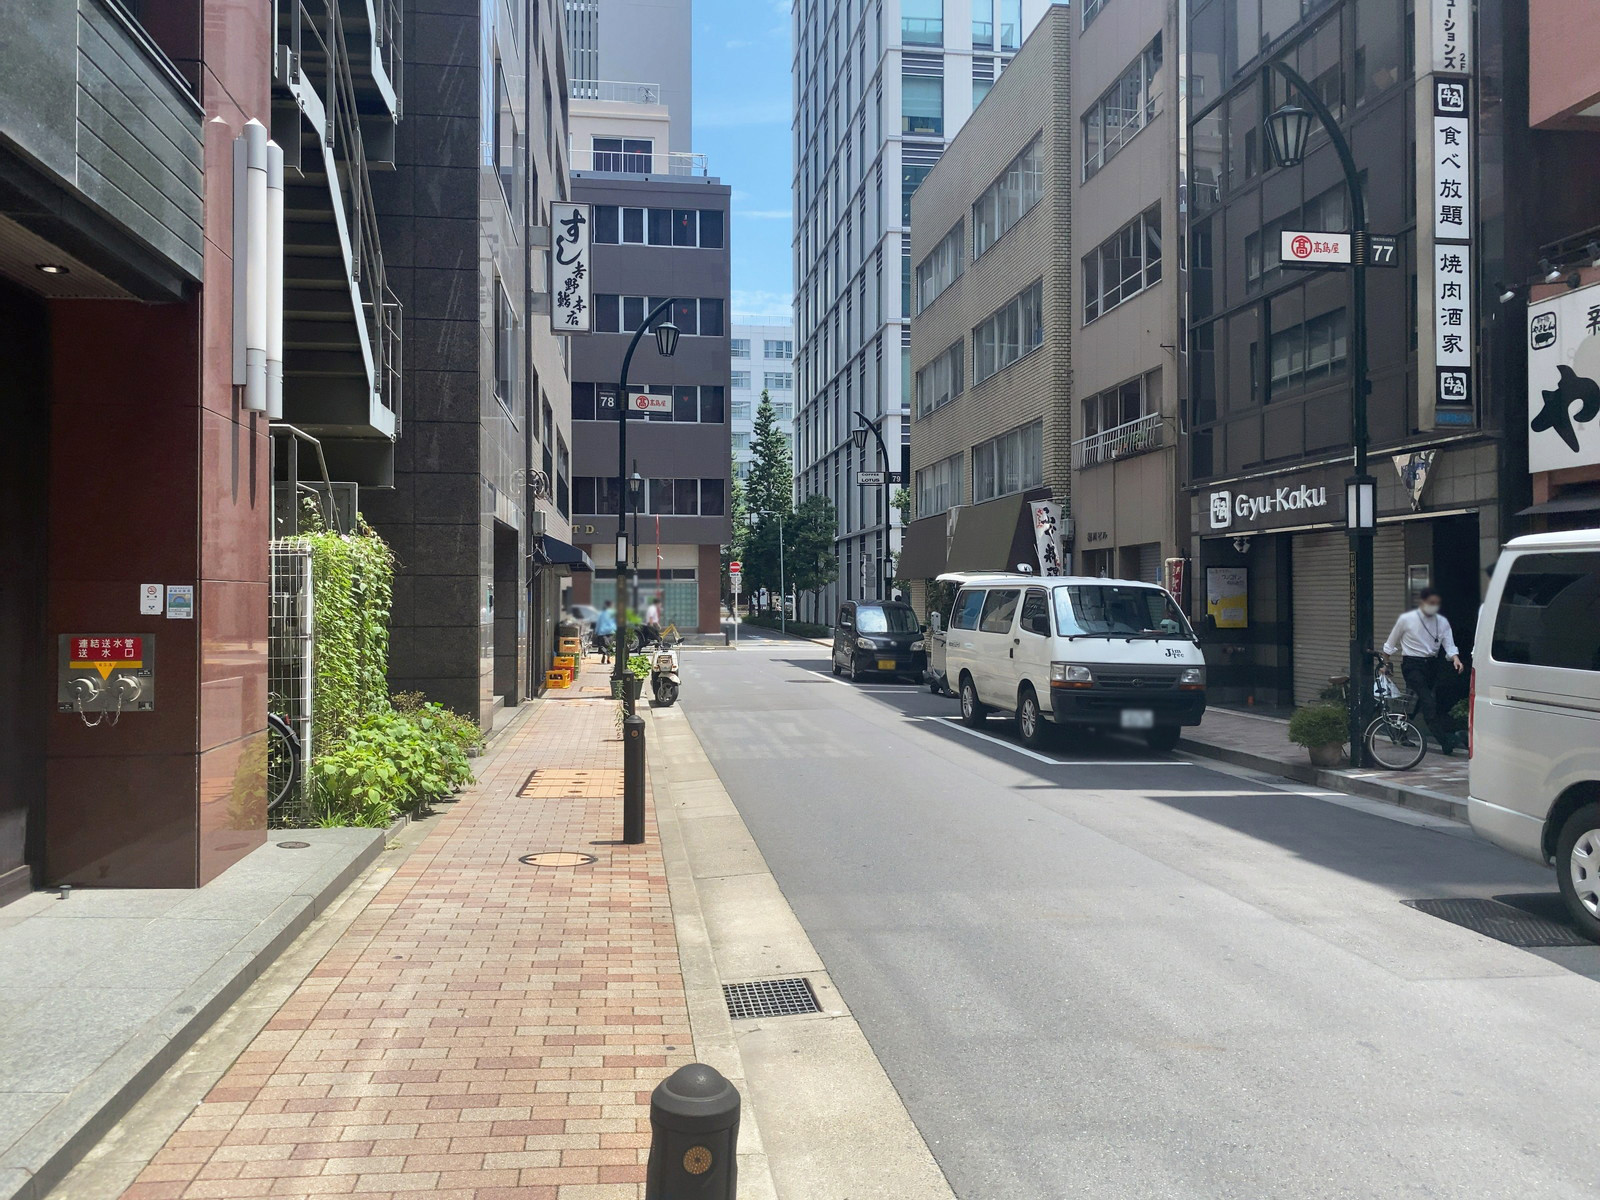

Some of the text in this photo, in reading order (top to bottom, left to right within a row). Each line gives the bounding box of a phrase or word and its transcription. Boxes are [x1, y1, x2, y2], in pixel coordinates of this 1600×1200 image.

[1440, 126, 1463, 225] 食べ放題
[556, 208, 587, 266] すし
[1372, 245, 1394, 262] 77
[1440, 254, 1464, 354] 焼肉酒家
[600, 396, 615, 408] 78
[1235, 484, 1327, 521] Gyu-Kaku
[78, 638, 135, 648] 連結送水管
